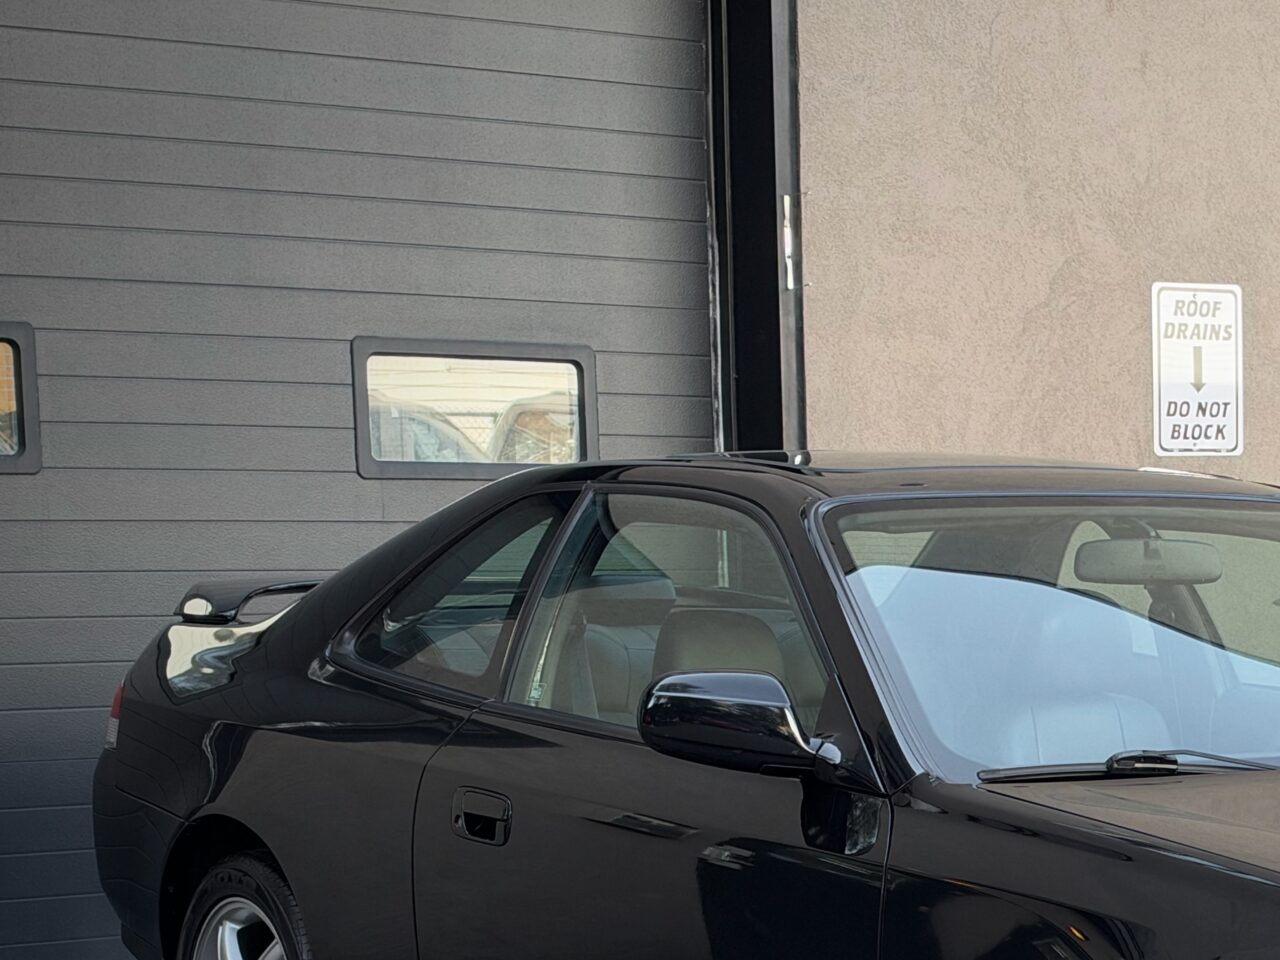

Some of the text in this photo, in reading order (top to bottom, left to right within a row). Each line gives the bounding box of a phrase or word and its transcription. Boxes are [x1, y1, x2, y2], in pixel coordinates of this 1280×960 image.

[1173, 299, 1222, 318] ROOF
[1163, 322, 1233, 341] DRAINS
[1166, 401, 1231, 418] DO NOT
[1170, 423, 1227, 441] BLOCK
